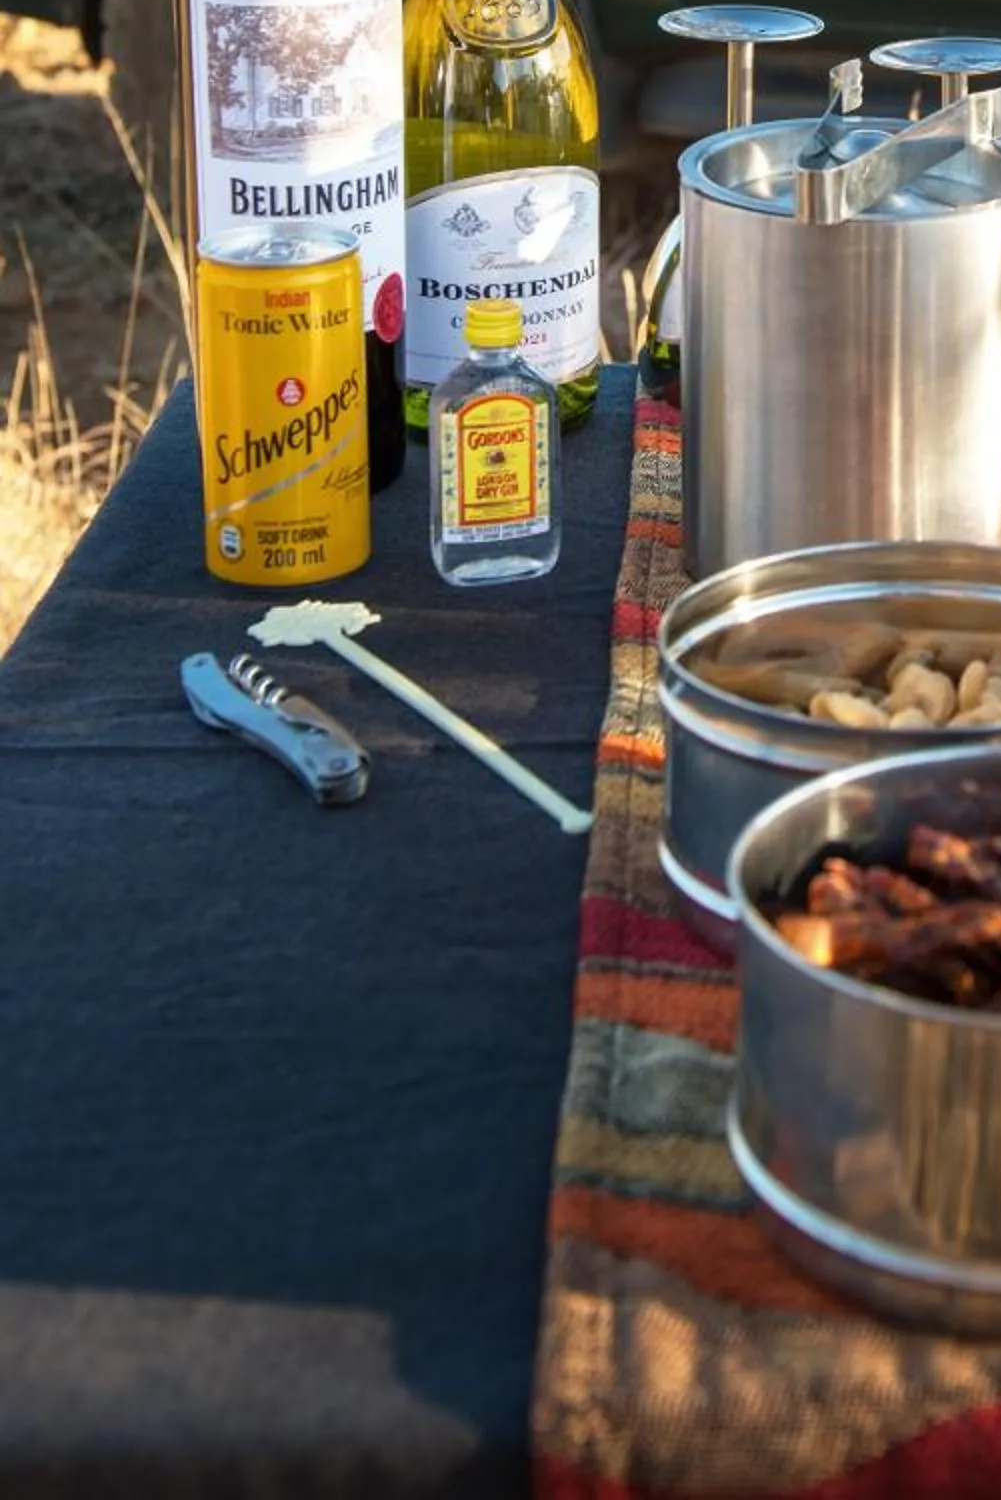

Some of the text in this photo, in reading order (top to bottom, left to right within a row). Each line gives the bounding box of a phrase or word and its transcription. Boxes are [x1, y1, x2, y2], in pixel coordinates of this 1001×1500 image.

[229, 165, 400, 218] BELLINGHAM
[221, 310, 283, 335] Tonic
[213, 368, 360, 486] Schweppes
[257, 526, 329, 545] SOFT DRINK
[264, 543, 327, 570] 200 ml
